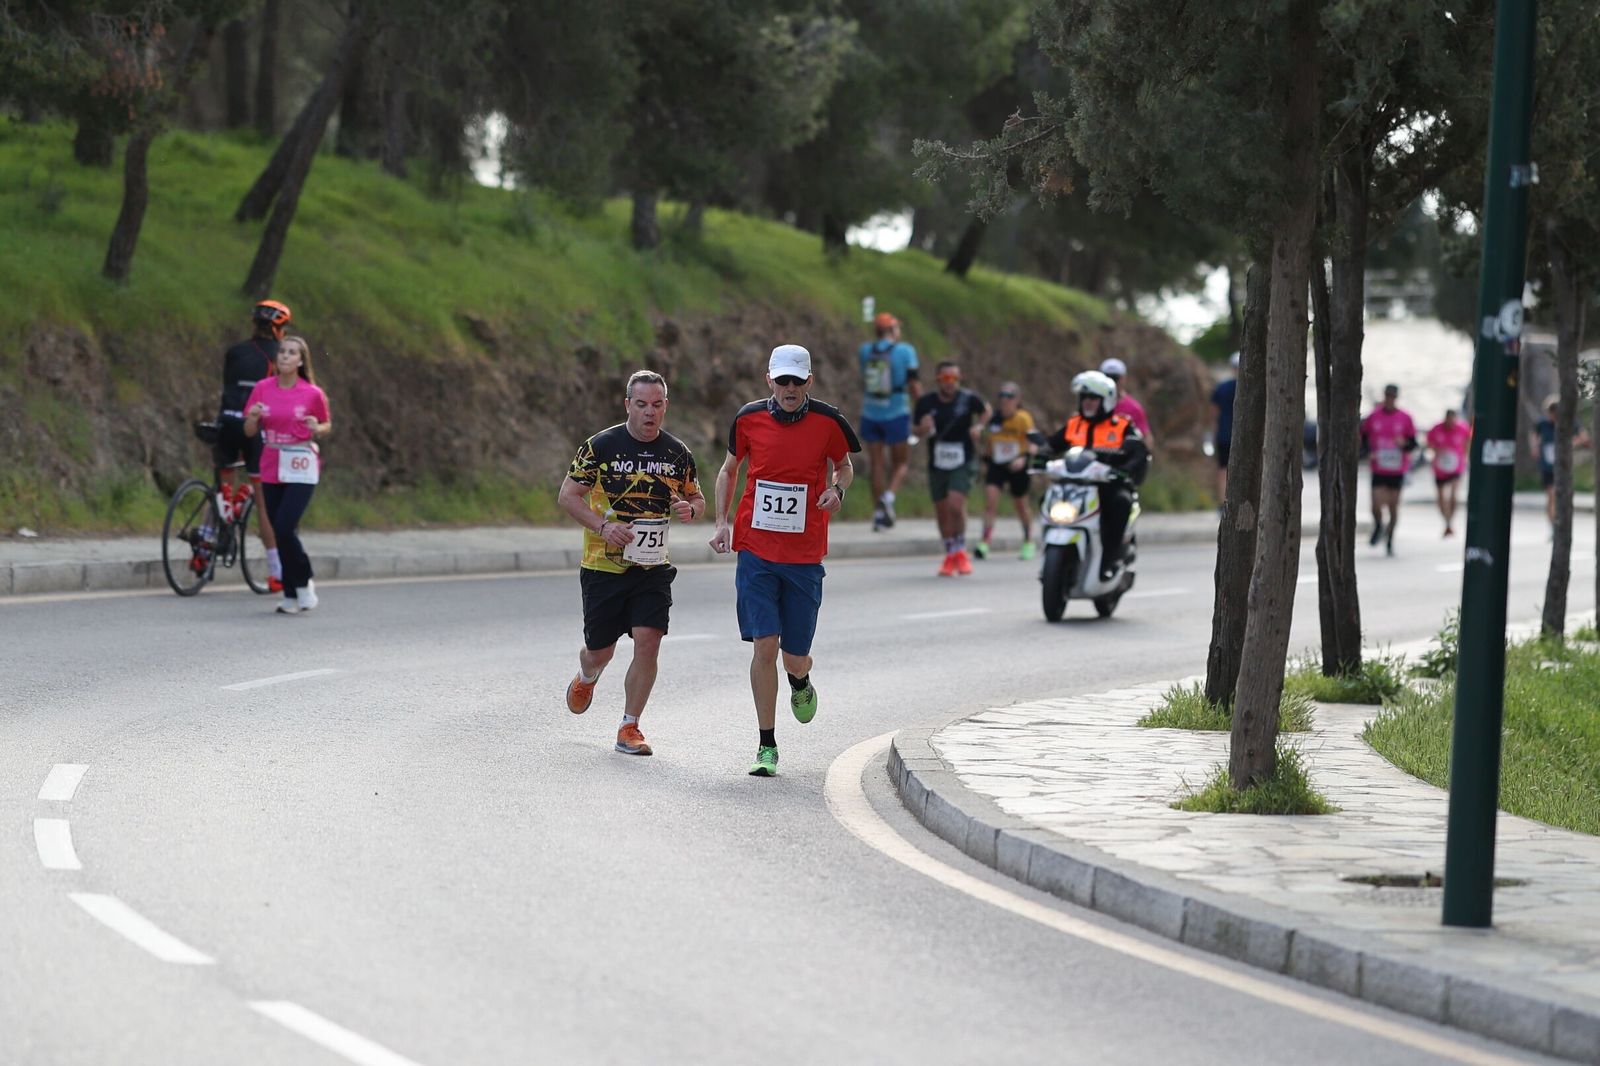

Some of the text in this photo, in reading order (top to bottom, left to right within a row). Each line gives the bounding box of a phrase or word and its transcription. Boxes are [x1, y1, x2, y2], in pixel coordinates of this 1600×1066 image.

[291, 457, 310, 470] 60
[613, 460, 677, 476] NO LIMITS
[762, 494, 798, 515] 512
[636, 530, 664, 548] 751
